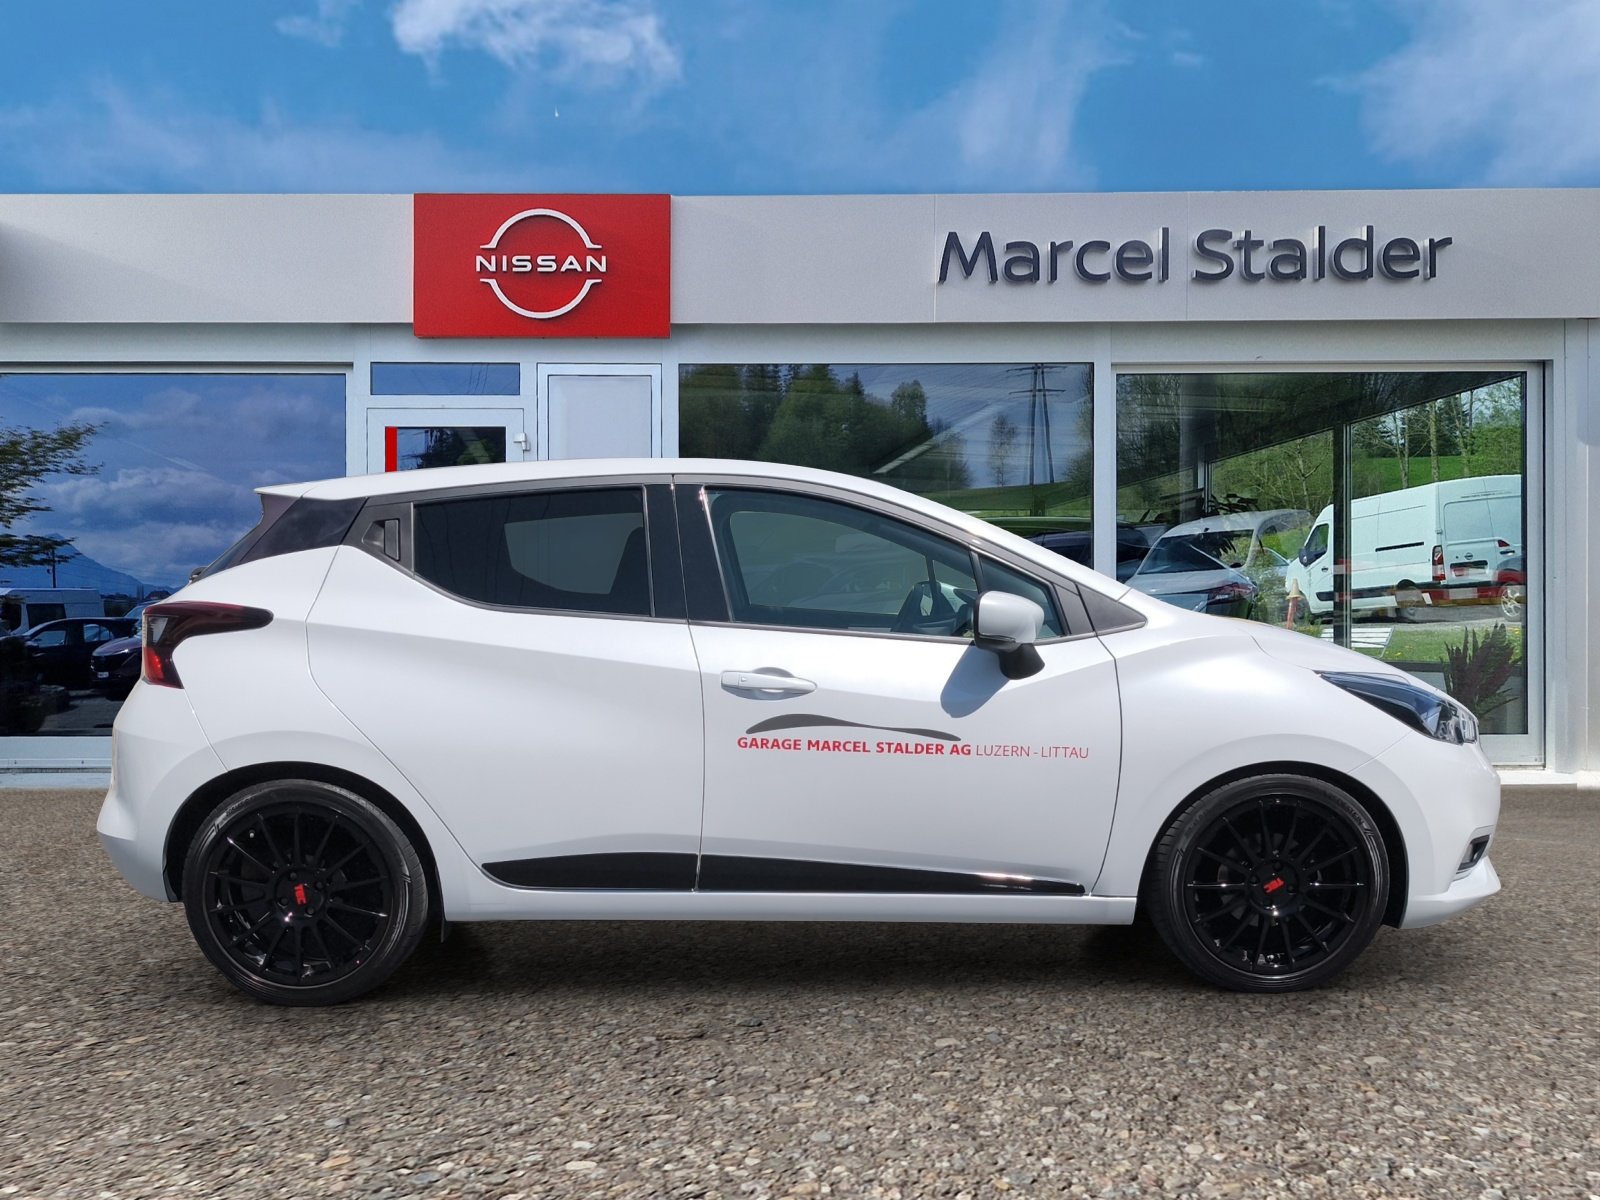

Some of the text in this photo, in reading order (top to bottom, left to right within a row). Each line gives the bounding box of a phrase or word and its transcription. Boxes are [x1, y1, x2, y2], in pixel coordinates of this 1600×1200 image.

[475, 254, 607, 273] NISSAN
[938, 224, 1453, 284] Marcel Stalder
[737, 736, 802, 751] GARAGE
[807, 739, 871, 753] MARCEL
[875, 741, 945, 756] STALDER
[949, 743, 972, 756] AG
[975, 744, 1030, 757] LUZERN
[1041, 746, 1090, 759] LITTAU
